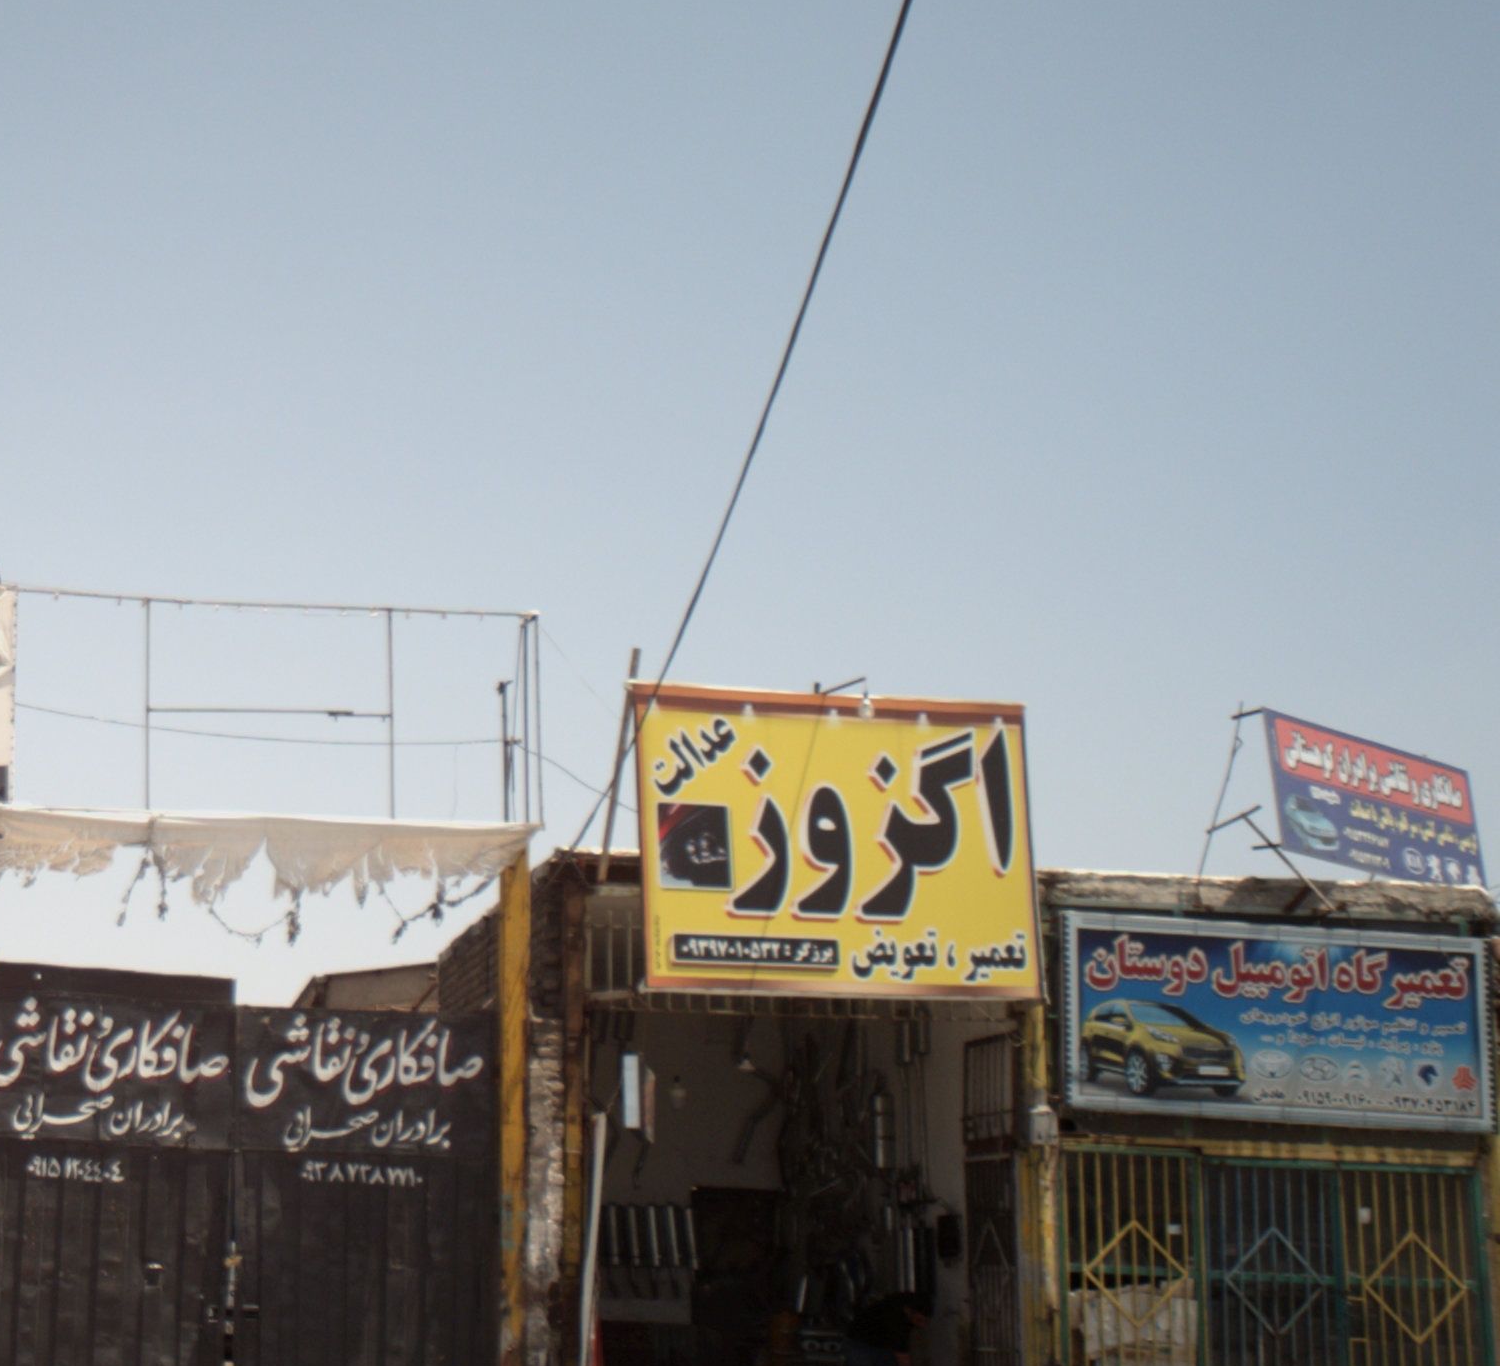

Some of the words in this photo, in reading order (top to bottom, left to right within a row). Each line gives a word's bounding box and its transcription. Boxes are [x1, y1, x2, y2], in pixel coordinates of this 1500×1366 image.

[653, 717, 737, 796] عدالت
[728, 727, 1014, 921] اگزوز
[851, 928, 938, 982] تعویض
[965, 929, 1029, 983] تعمیر
[1084, 934, 1209, 996] دوستان
[1212, 941, 1330, 1003] اتومبیل
[84, 1009, 230, 1092] صافکاری
[245, 1013, 354, 1108] نقاشی
[343, 1017, 485, 1105] صافکاری
[109, 1101, 189, 1140] برادران
[370, 1108, 452, 1150] برادران
